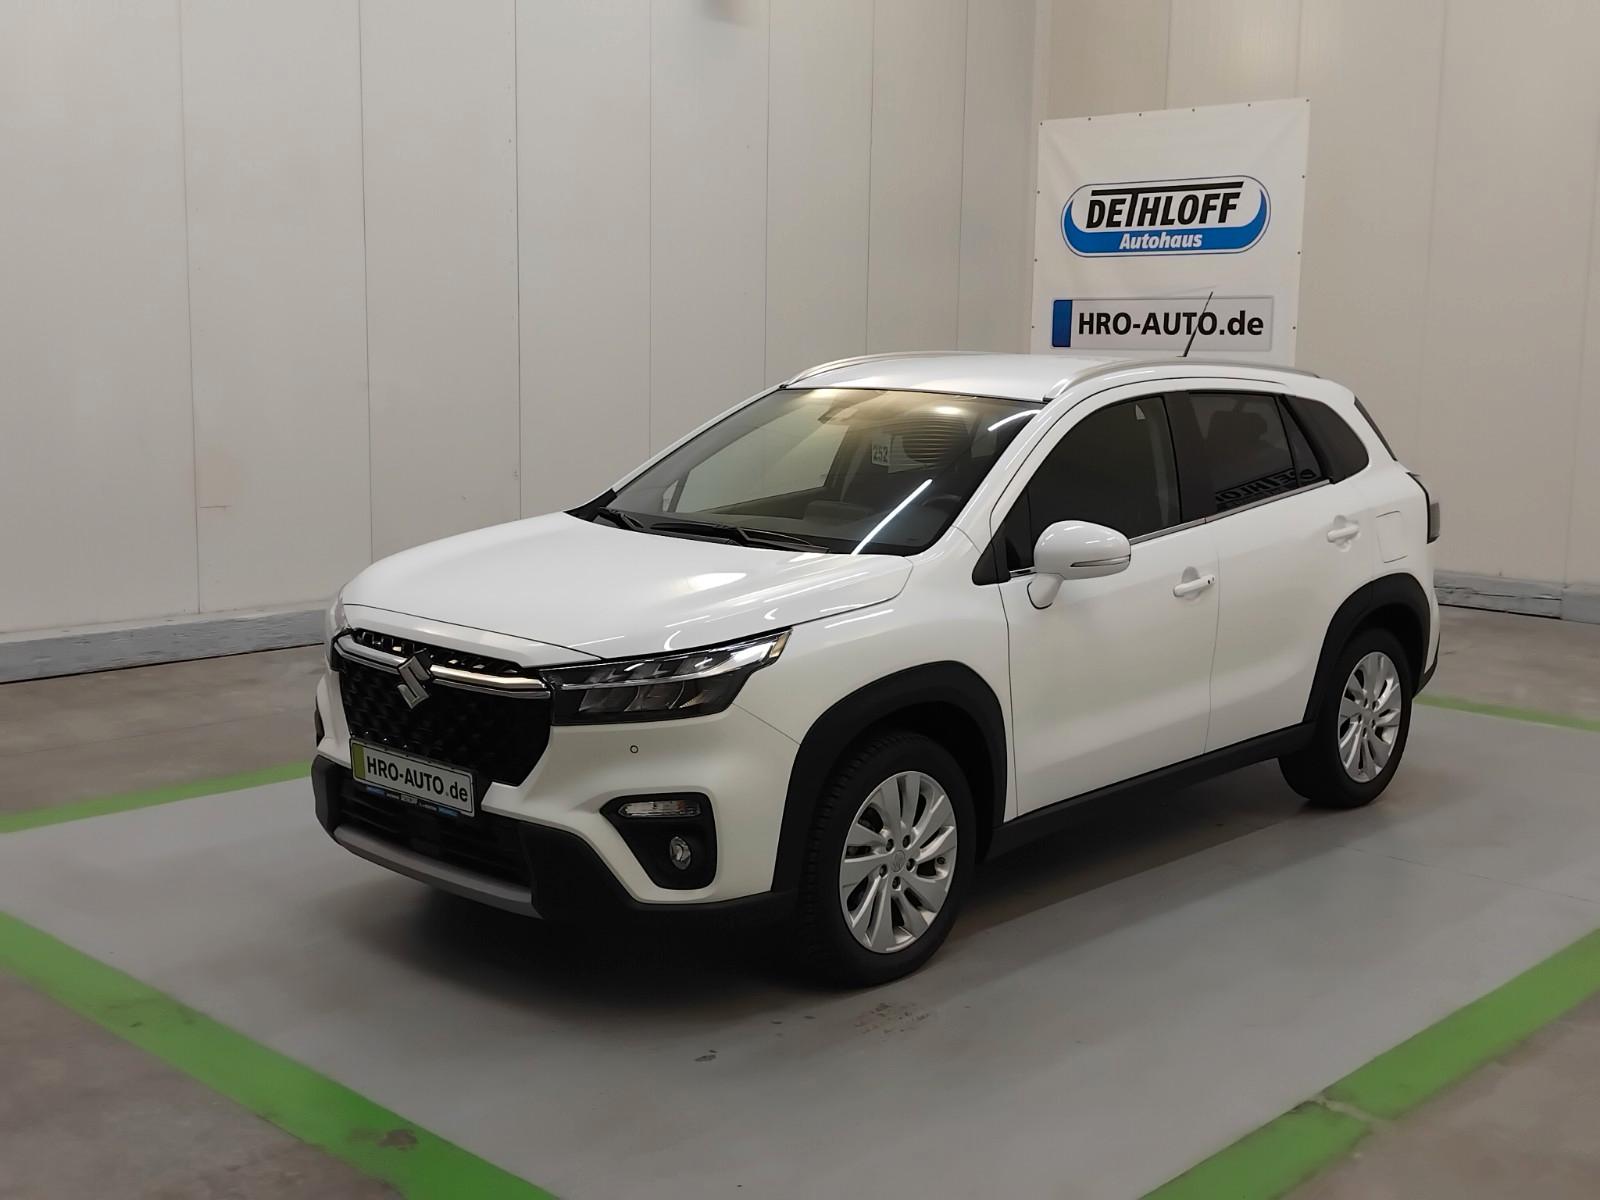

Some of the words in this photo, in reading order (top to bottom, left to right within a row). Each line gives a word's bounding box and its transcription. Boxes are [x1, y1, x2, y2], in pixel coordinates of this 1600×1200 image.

[1086, 181, 1244, 229] DETHLOFF
[1119, 232, 1202, 250] Autohaus
[1078, 310, 1264, 336] HRO-AUTO.de
[366, 755, 468, 802] HRO-AUTO.de
